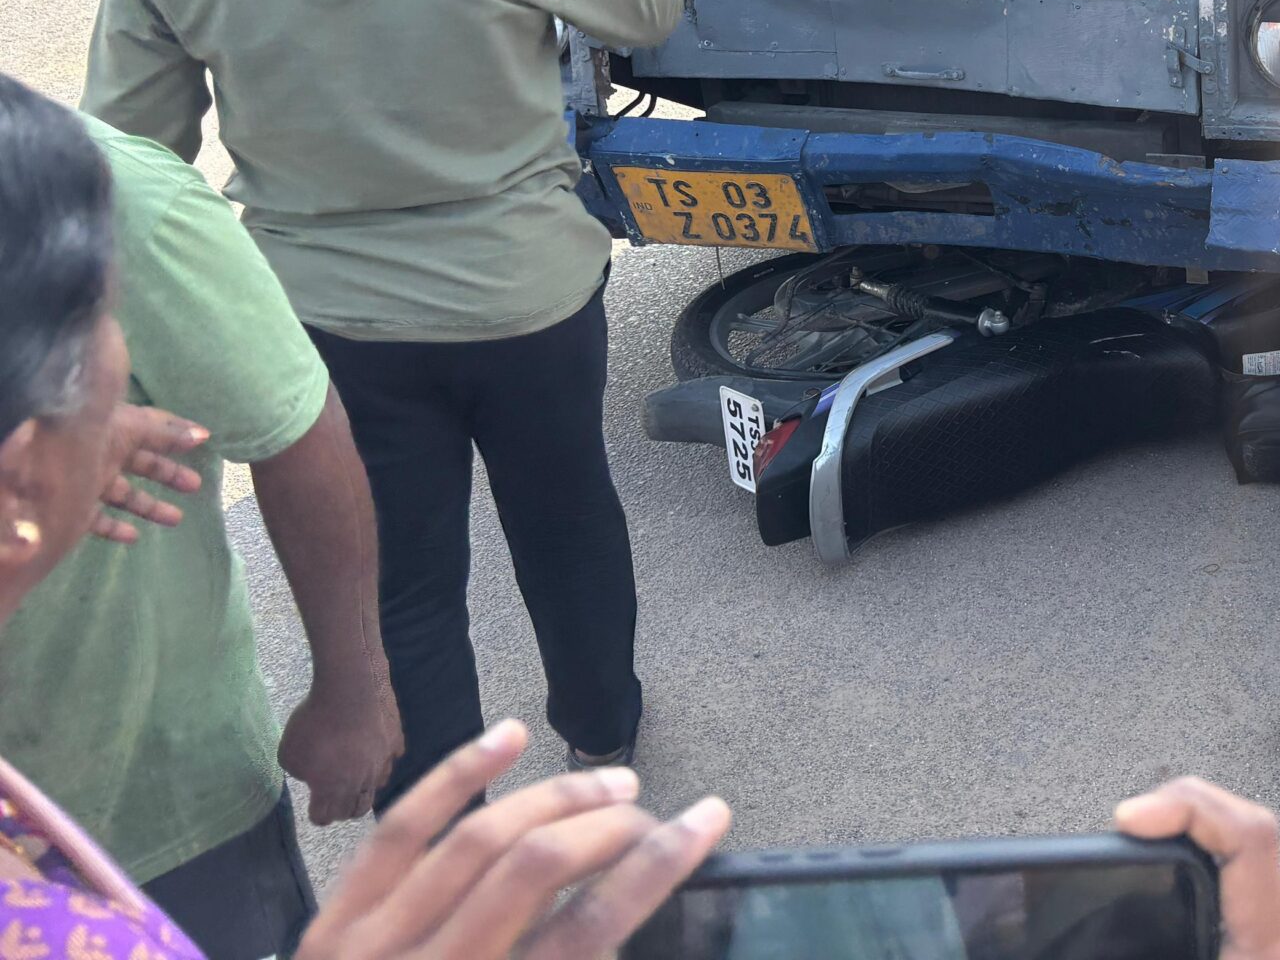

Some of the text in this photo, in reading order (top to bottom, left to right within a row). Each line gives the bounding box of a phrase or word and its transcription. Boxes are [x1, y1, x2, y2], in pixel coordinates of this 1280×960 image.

[632, 201, 653, 212] IND
[646, 177, 772, 209] TS 03
[673, 211, 702, 239] Z
[727, 397, 752, 482] 5725
